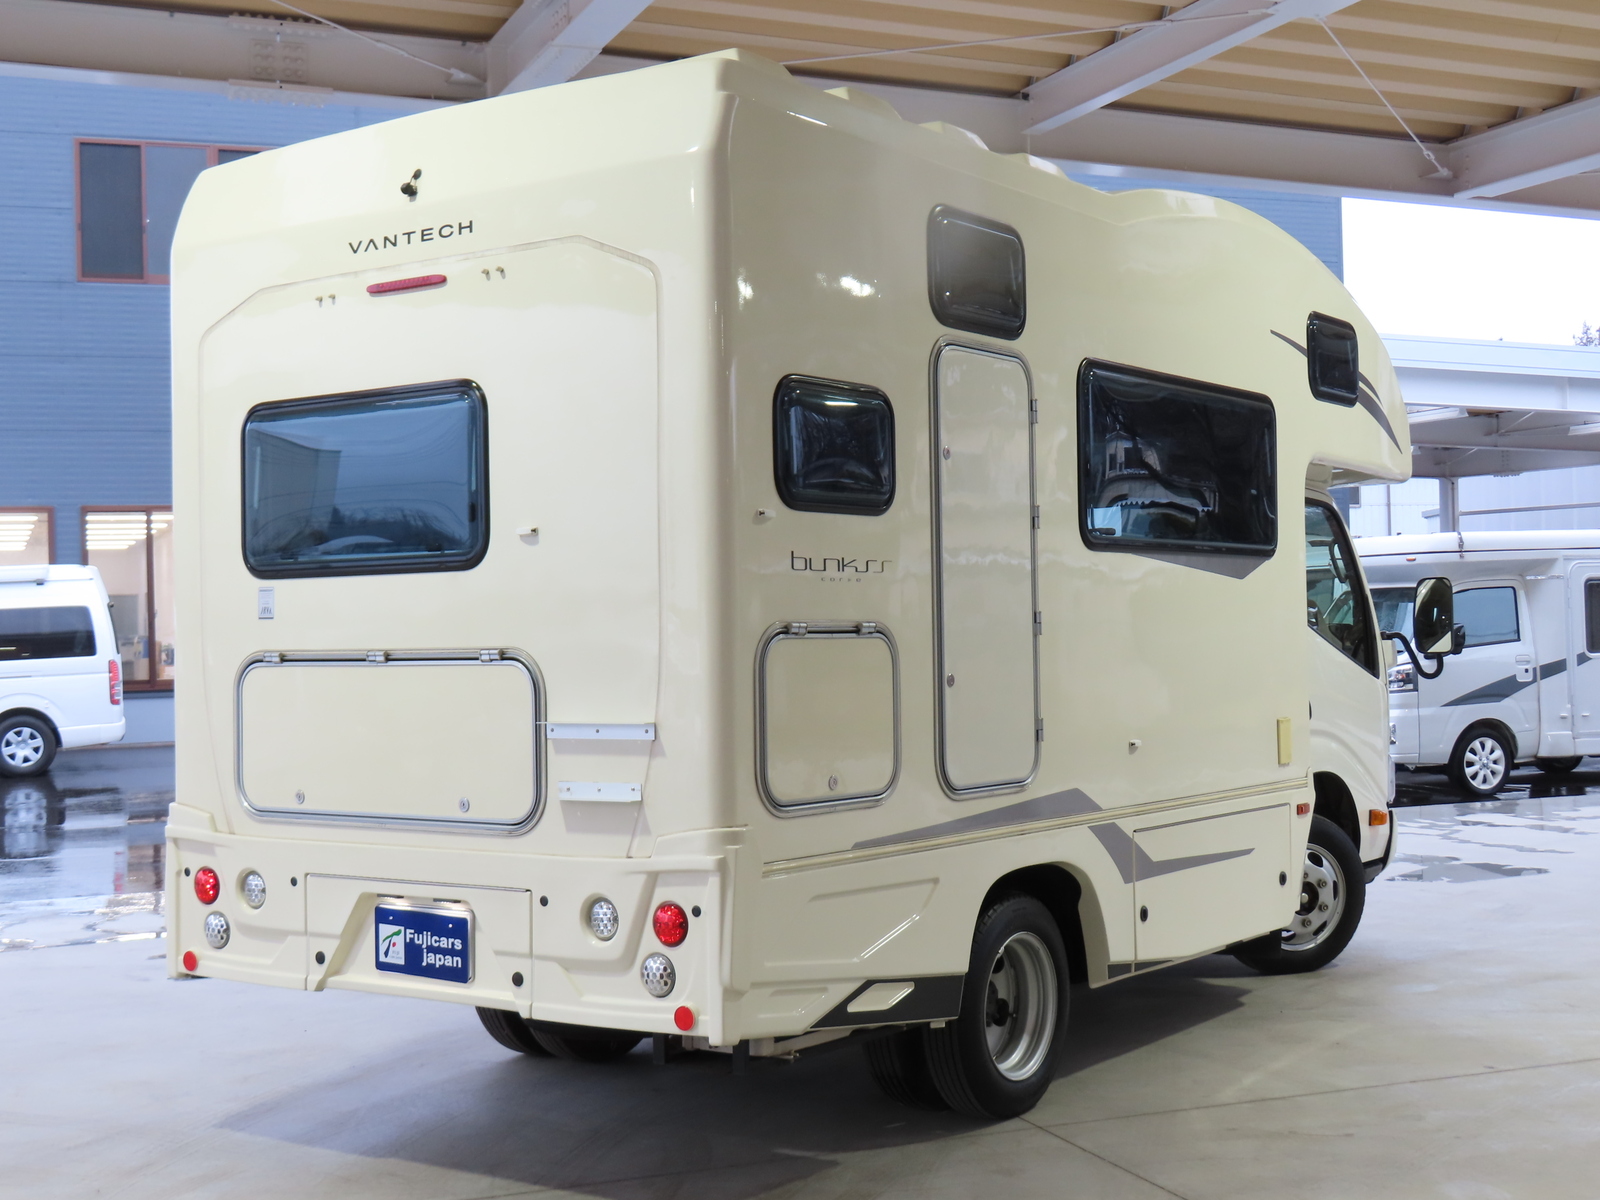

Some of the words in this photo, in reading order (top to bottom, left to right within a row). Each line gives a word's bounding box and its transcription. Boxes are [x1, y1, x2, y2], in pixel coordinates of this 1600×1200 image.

[348, 219, 474, 254] VANTECH
[405, 928, 463, 950] Fujicars
[421, 949, 462, 968] japan
